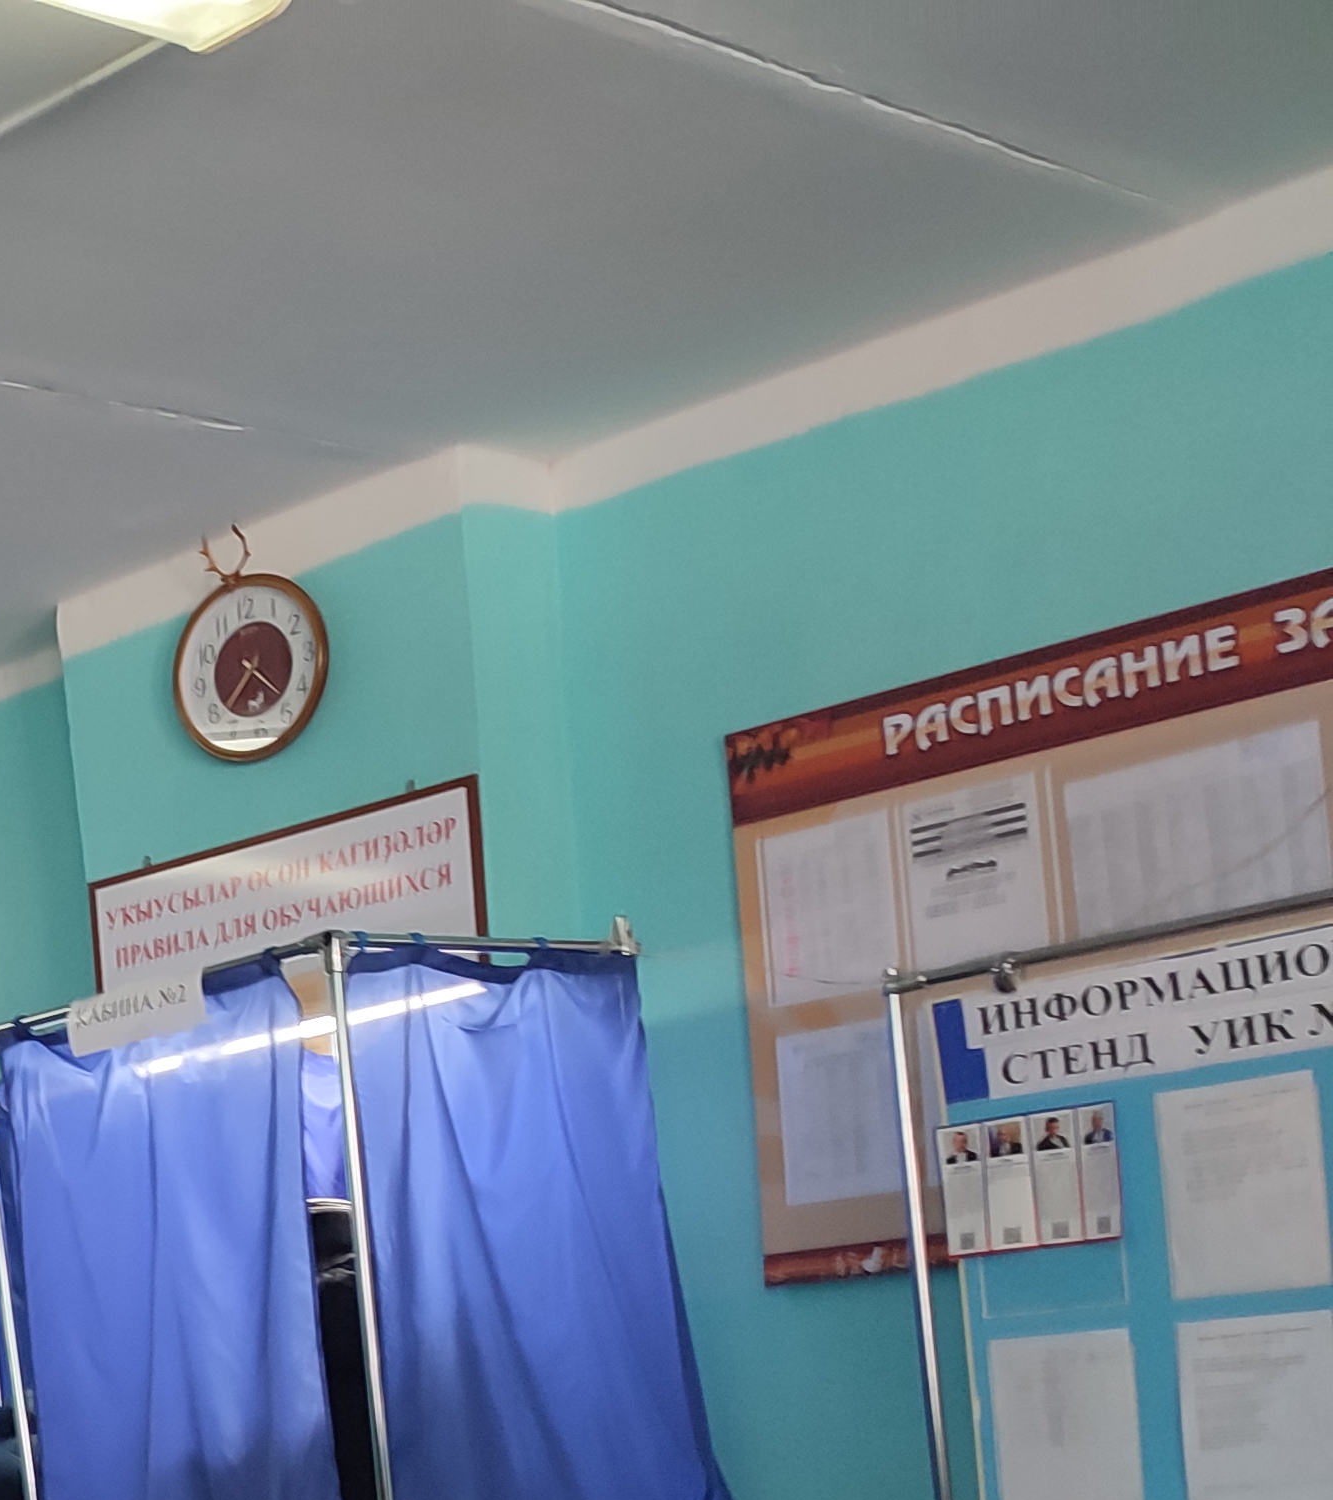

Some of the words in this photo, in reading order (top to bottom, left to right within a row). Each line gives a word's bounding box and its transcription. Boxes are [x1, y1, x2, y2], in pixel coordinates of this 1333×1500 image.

[236, 596, 256, 621] 12
[215, 614, 228, 637] 11
[287, 613, 302, 636] 2
[198, 642, 215, 667] 10
[303, 640, 315, 662] 3
[193, 677, 206, 698] 9
[295, 672, 310, 694] 4
[881, 625, 1241, 756] РАСПИСАНИЕ
[207, 703, 221, 724] 8
[280, 703, 294, 724] 5
[116, 927, 209, 969] ПРАВИЛА
[214, 913, 258, 950] ДЛЯ
[262, 862, 452, 931] ОБУЧАЮЩИХСЯ
[1002, 1031, 1156, 1085] СТЕНД
[1188, 1007, 1296, 1056] УИК
